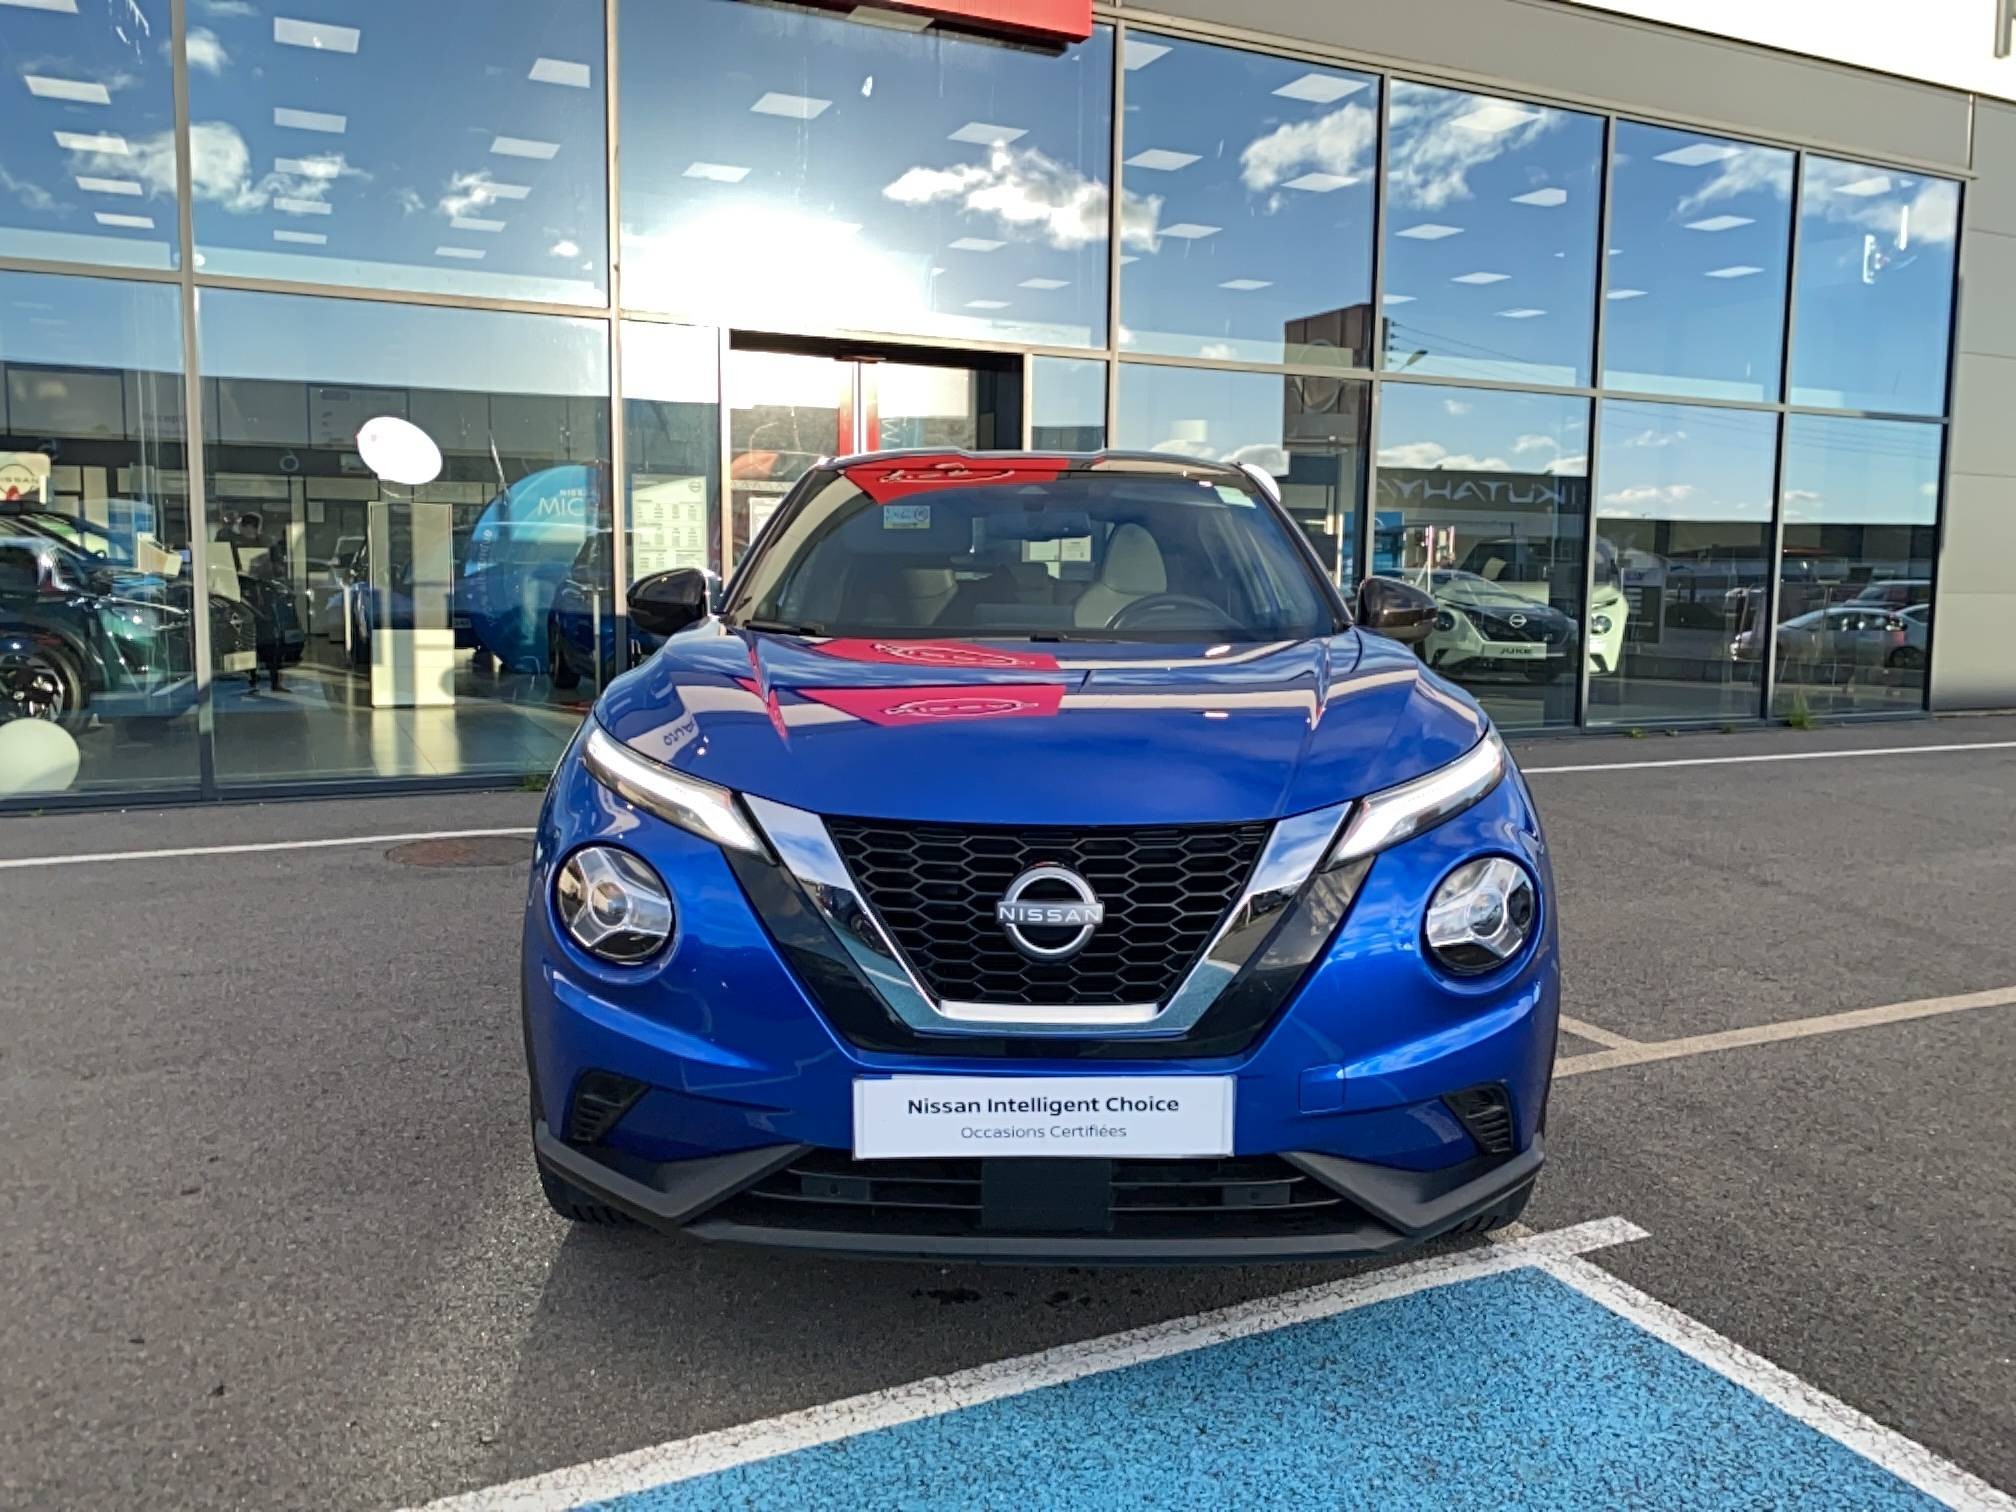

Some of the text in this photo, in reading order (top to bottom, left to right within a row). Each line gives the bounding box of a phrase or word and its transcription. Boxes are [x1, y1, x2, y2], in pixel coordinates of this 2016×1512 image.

[537, 497, 586, 516] MIC
[999, 906, 1100, 922] NISSAN
[908, 1095, 1180, 1116] Nissan Intelligent Choice
[961, 1123, 1127, 1139] Occasions Certifiées
